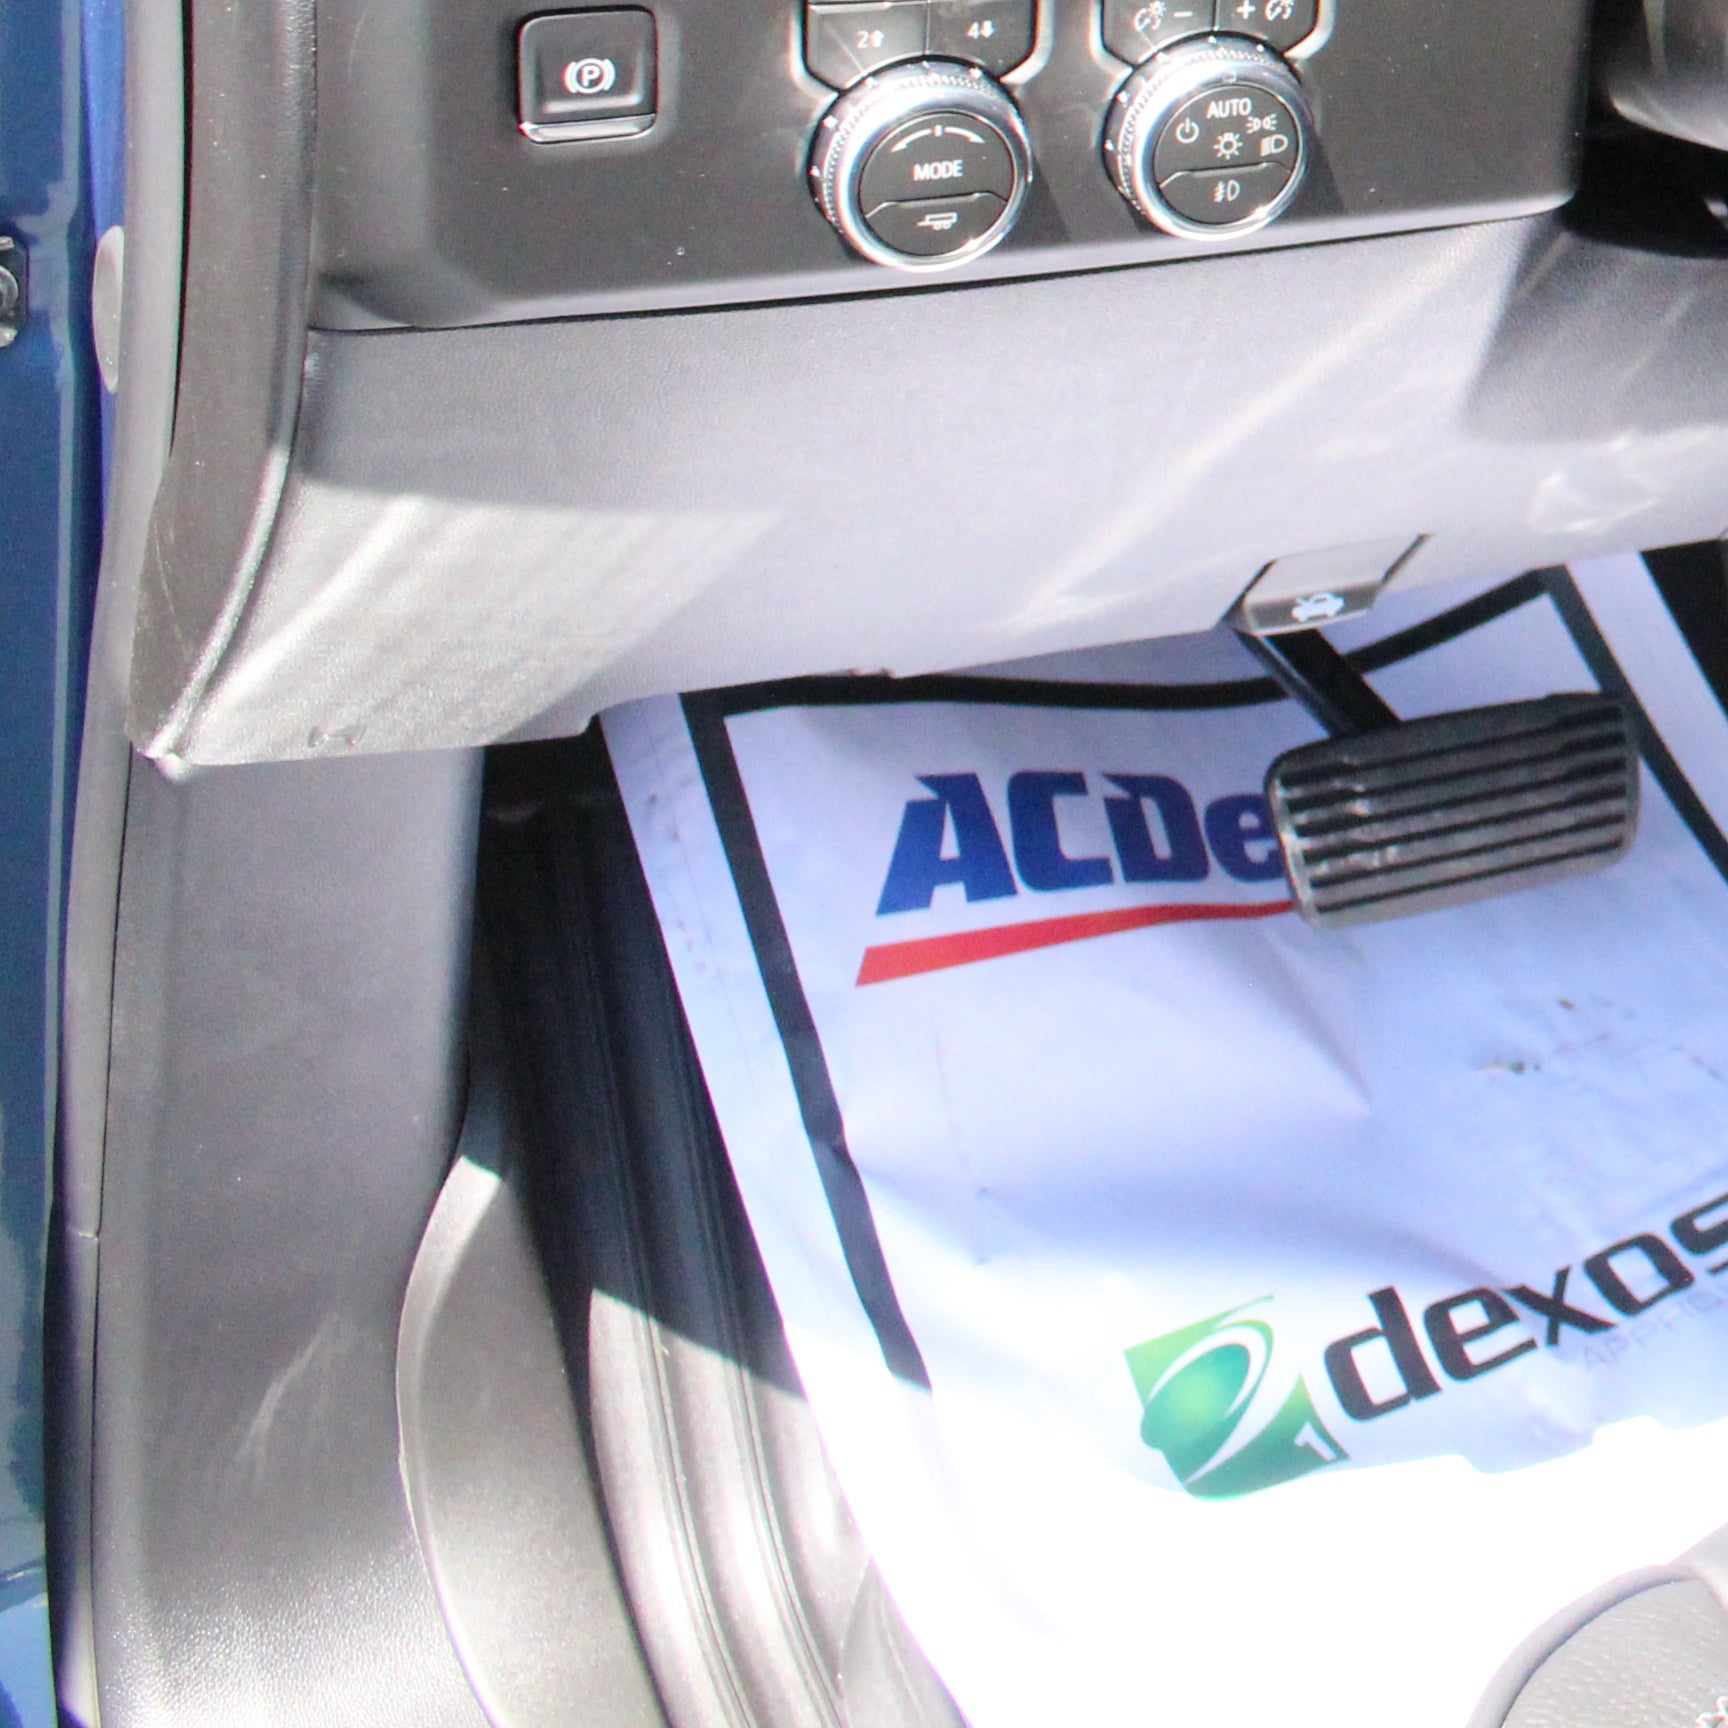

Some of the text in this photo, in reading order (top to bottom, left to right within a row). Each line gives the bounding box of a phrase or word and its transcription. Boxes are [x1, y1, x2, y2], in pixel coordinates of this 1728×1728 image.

[1206, 97, 1252, 119] AUTO
[913, 159, 963, 181] MODE
[875, 770, 1288, 917] ACDe
